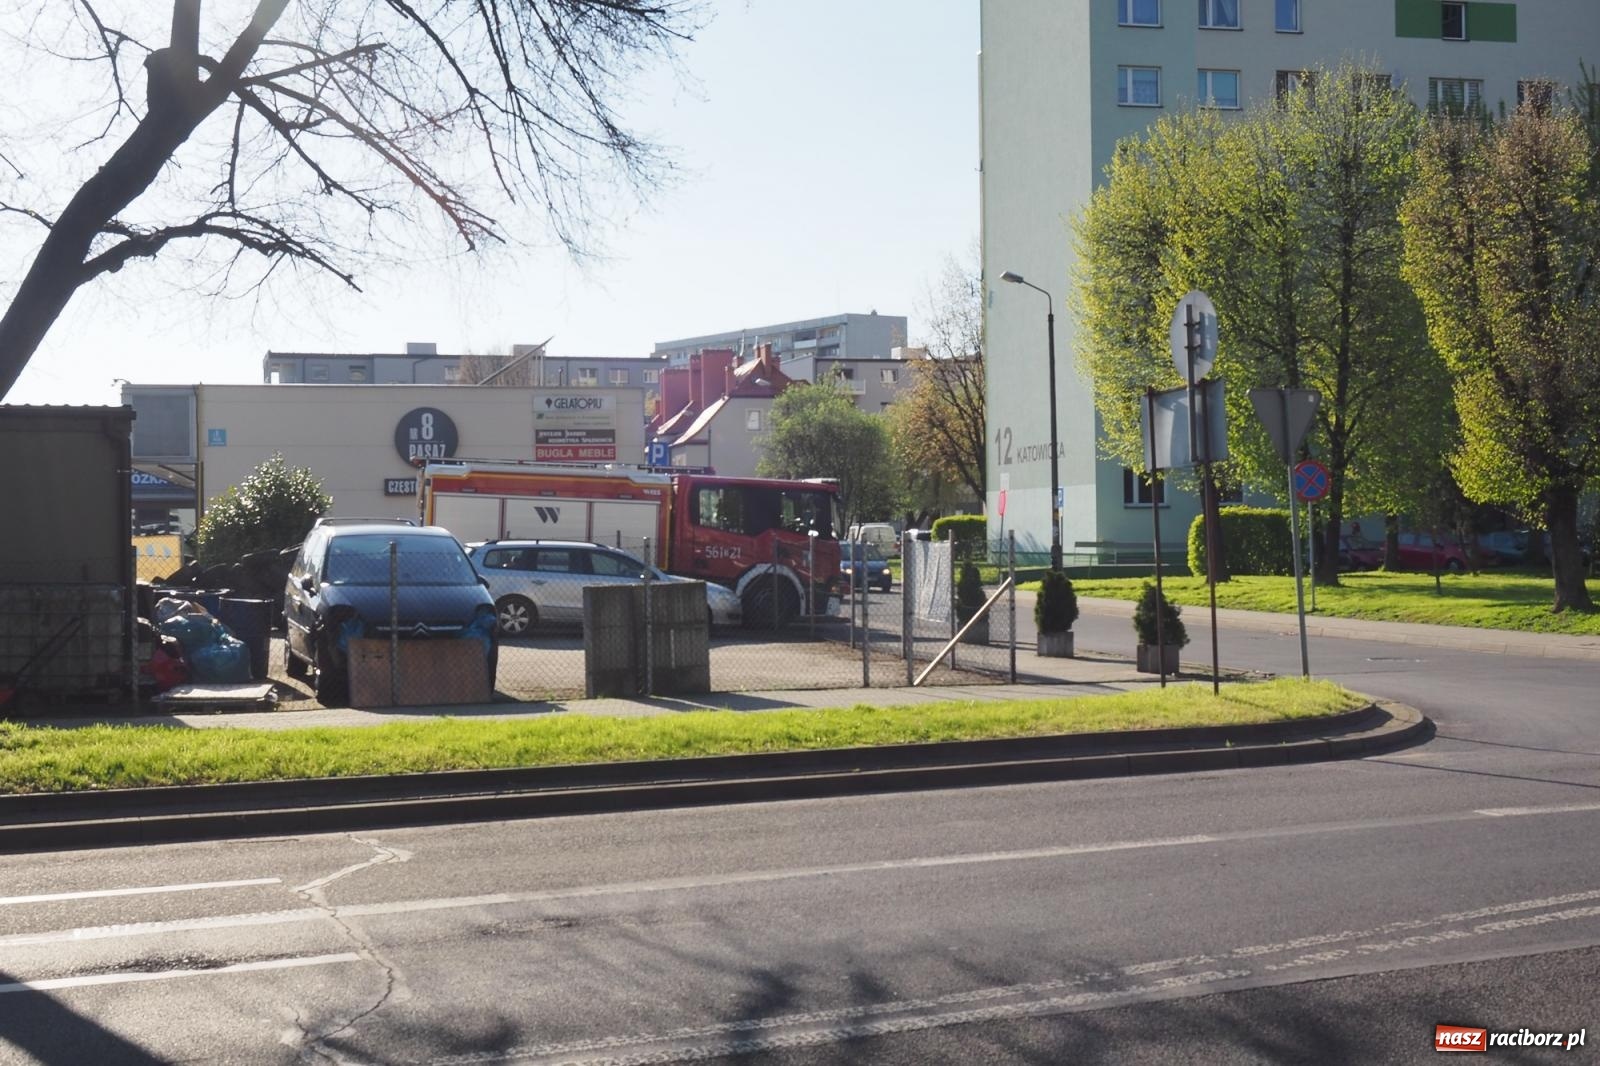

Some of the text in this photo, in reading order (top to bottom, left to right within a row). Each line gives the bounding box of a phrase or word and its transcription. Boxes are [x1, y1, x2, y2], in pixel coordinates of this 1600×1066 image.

[421, 413, 434, 440] 8
[537, 448, 614, 458] BUGLA MEBLE
[652, 444, 664, 463] P
[995, 427, 1066, 466] 12 KATOWICA
